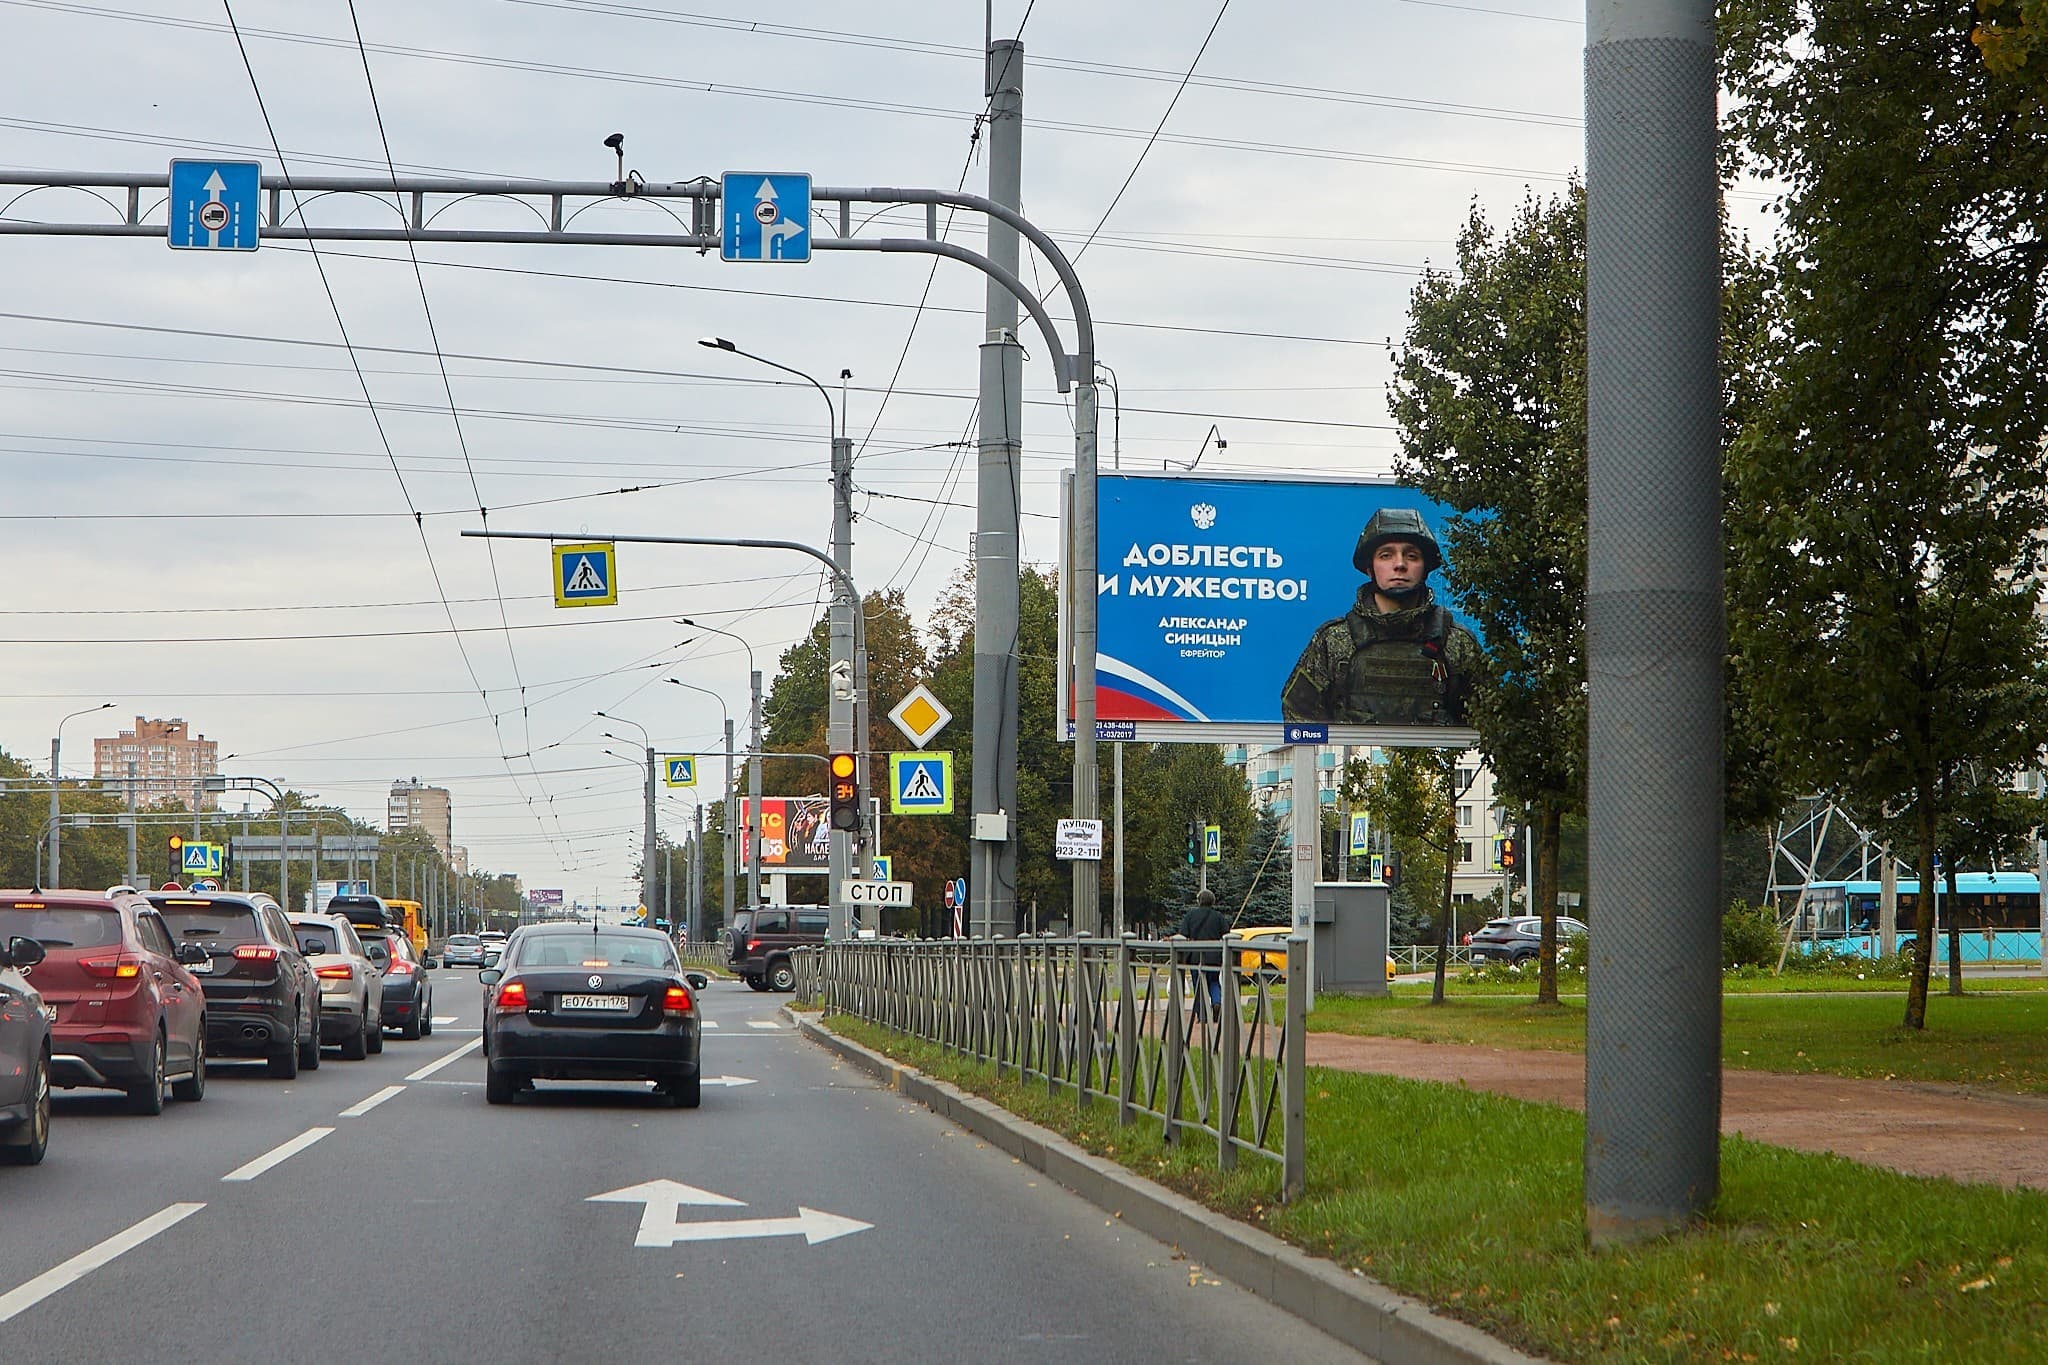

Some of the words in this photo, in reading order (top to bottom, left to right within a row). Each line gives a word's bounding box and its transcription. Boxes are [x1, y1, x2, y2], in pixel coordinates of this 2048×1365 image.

[1123, 543, 1283, 568] ДОБЛЕСТЬ
[1098, 574, 1118, 595] И
[1129, 575, 1308, 601] МУЖЕСТВО!
[1158, 617, 1248, 631] АЛЕКСАНДР
[1165, 633, 1241, 647] СИНИЦЫН
[1180, 648, 1226, 658] ЕФРЕЙТОР
[1302, 730, 1322, 738] Russ
[836, 784, 854, 799] 34
[851, 884, 903, 902] СТОП
